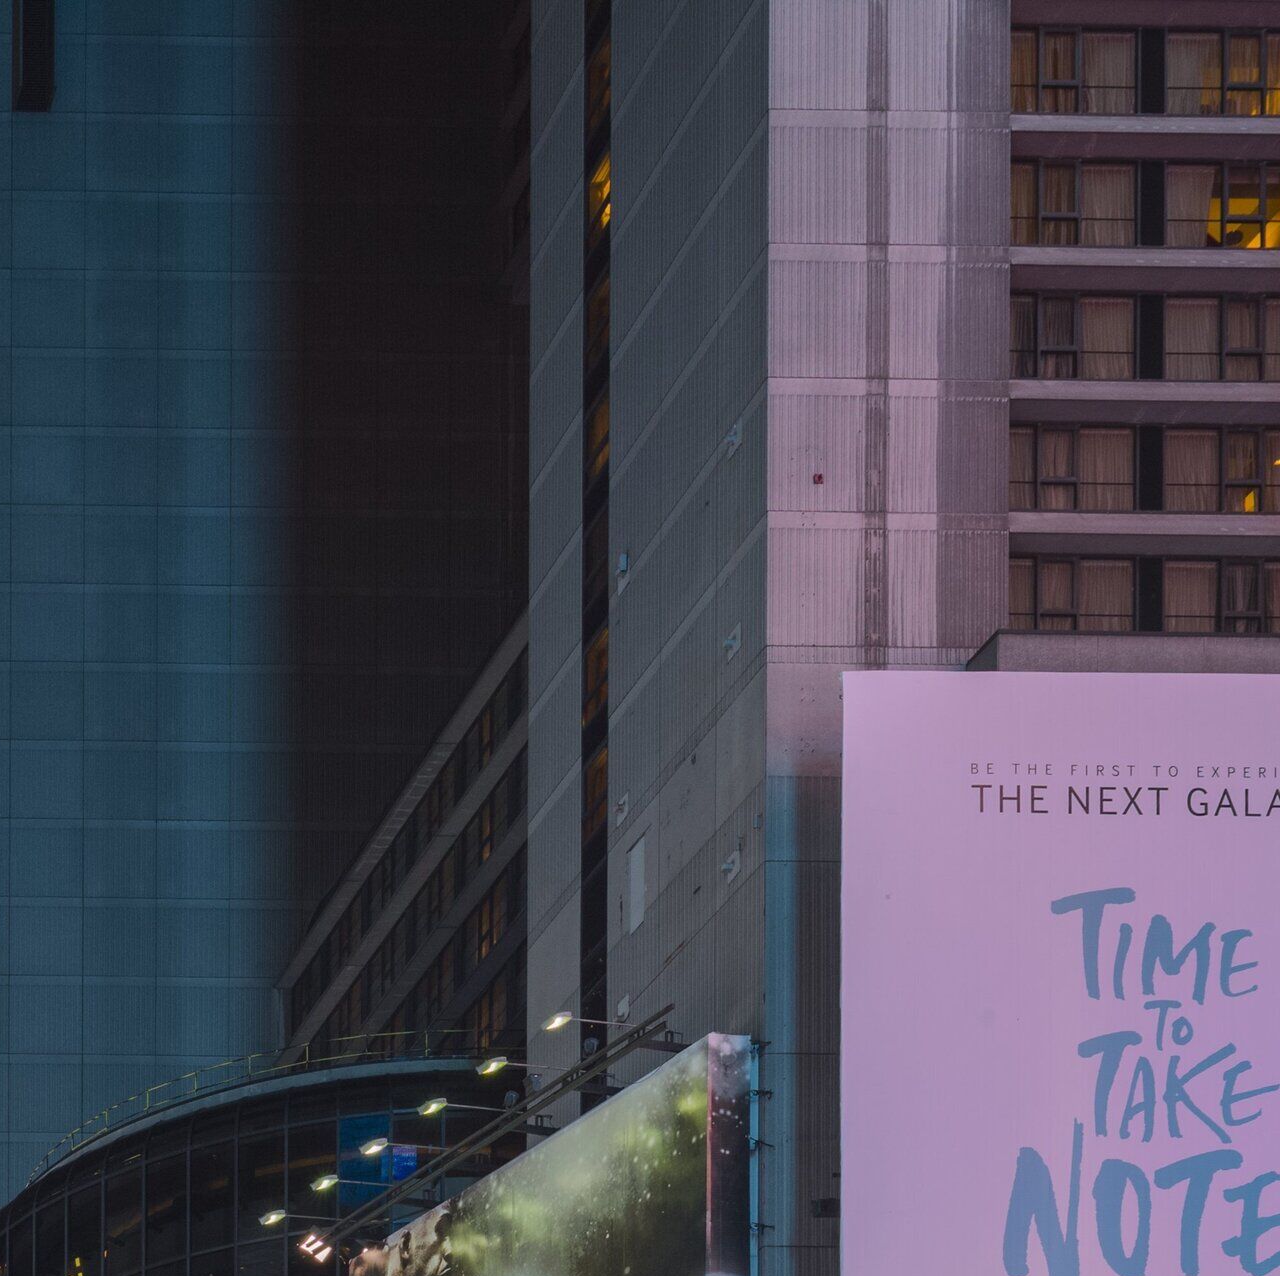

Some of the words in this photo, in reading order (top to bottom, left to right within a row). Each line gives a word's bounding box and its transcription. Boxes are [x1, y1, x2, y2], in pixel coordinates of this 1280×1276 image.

[971, 763, 995, 775] BE
[1013, 764, 1053, 776] THE
[1071, 764, 1135, 777] FIRST
[1154, 765, 1179, 777] TO
[1197, 766, 1277, 778] EXPERI
[971, 785, 1049, 814] THE
[1068, 787, 1168, 817] NEXT
[1051, 887, 1258, 1005] TIME
[1077, 1031, 1280, 1143] TAKE
